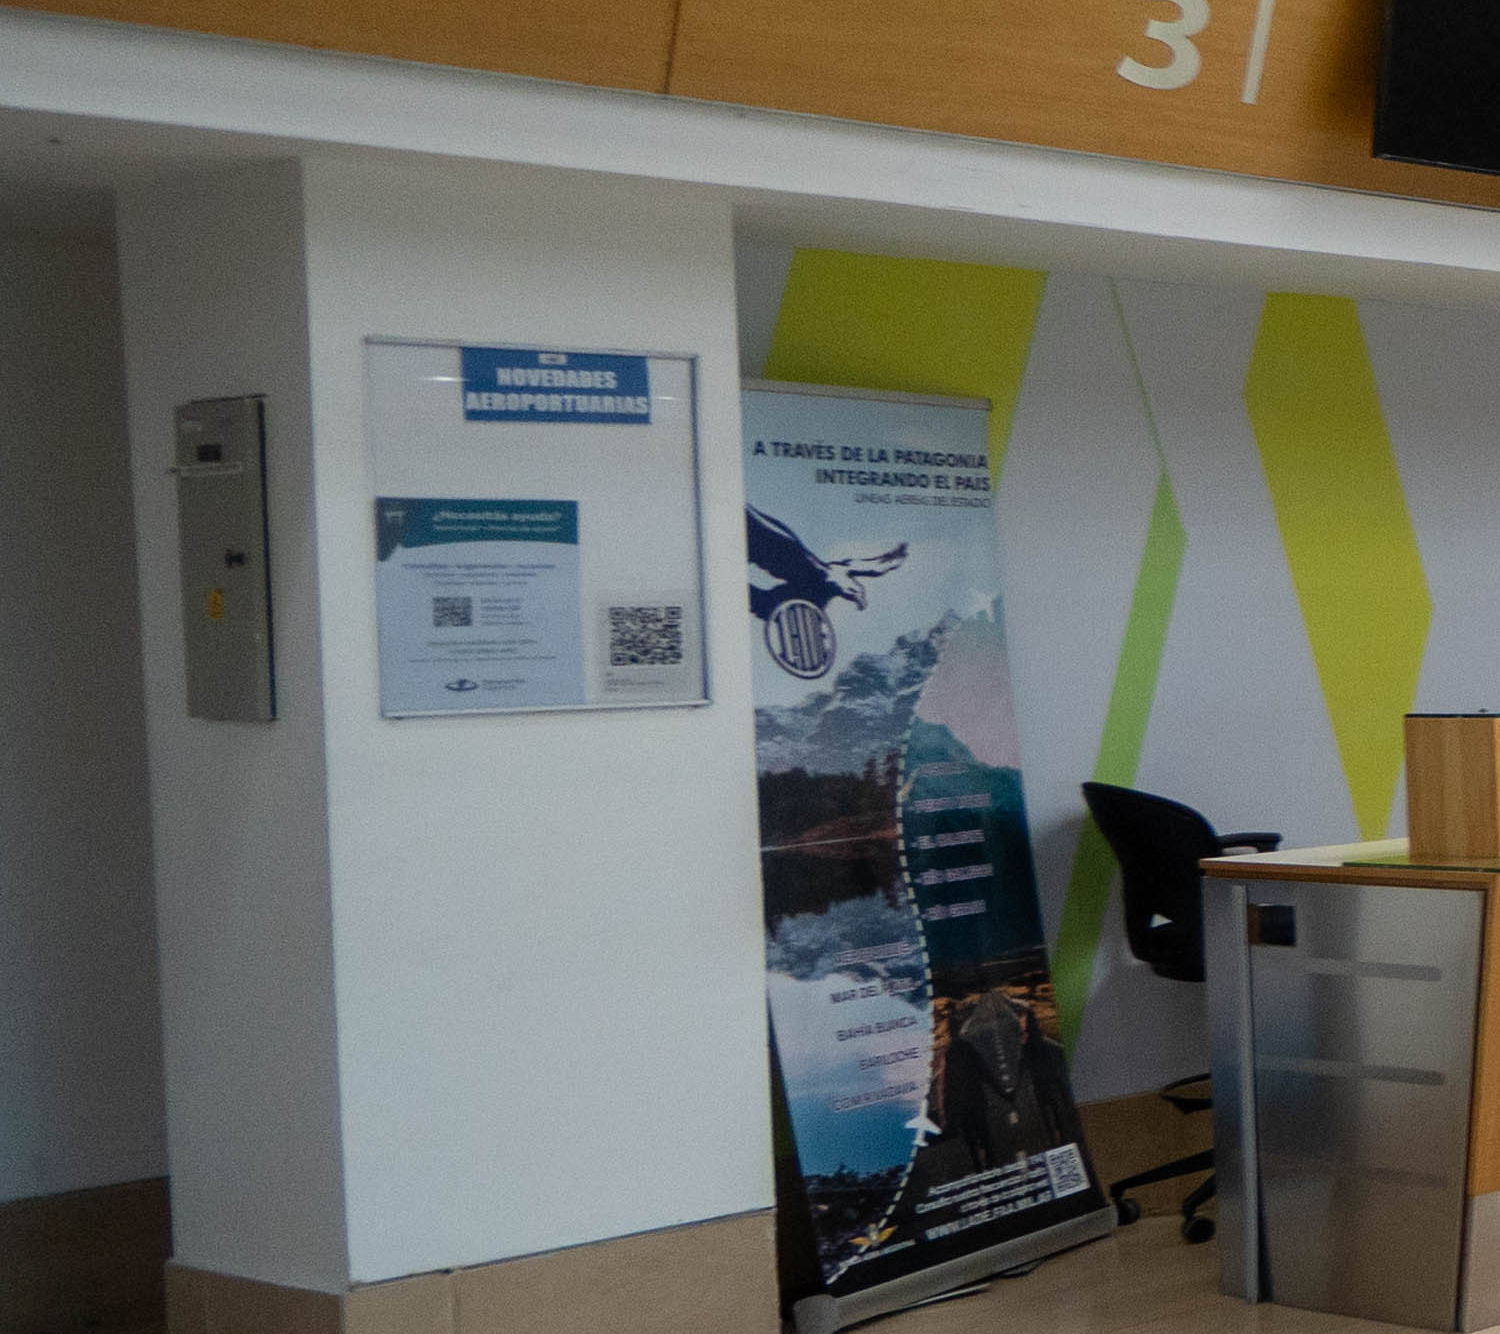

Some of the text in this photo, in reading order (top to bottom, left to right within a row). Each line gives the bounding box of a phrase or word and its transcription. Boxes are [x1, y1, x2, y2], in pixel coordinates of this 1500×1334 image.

[497, 367, 618, 389] NOVEDADES
[466, 391, 648, 414] AEROPORTUARIAS
[753, 440, 989, 469] A TRAVÉS DE LA PATAGONIA
[815, 469, 930, 489] INTEGRANDO
[935, 475, 950, 490] EL
